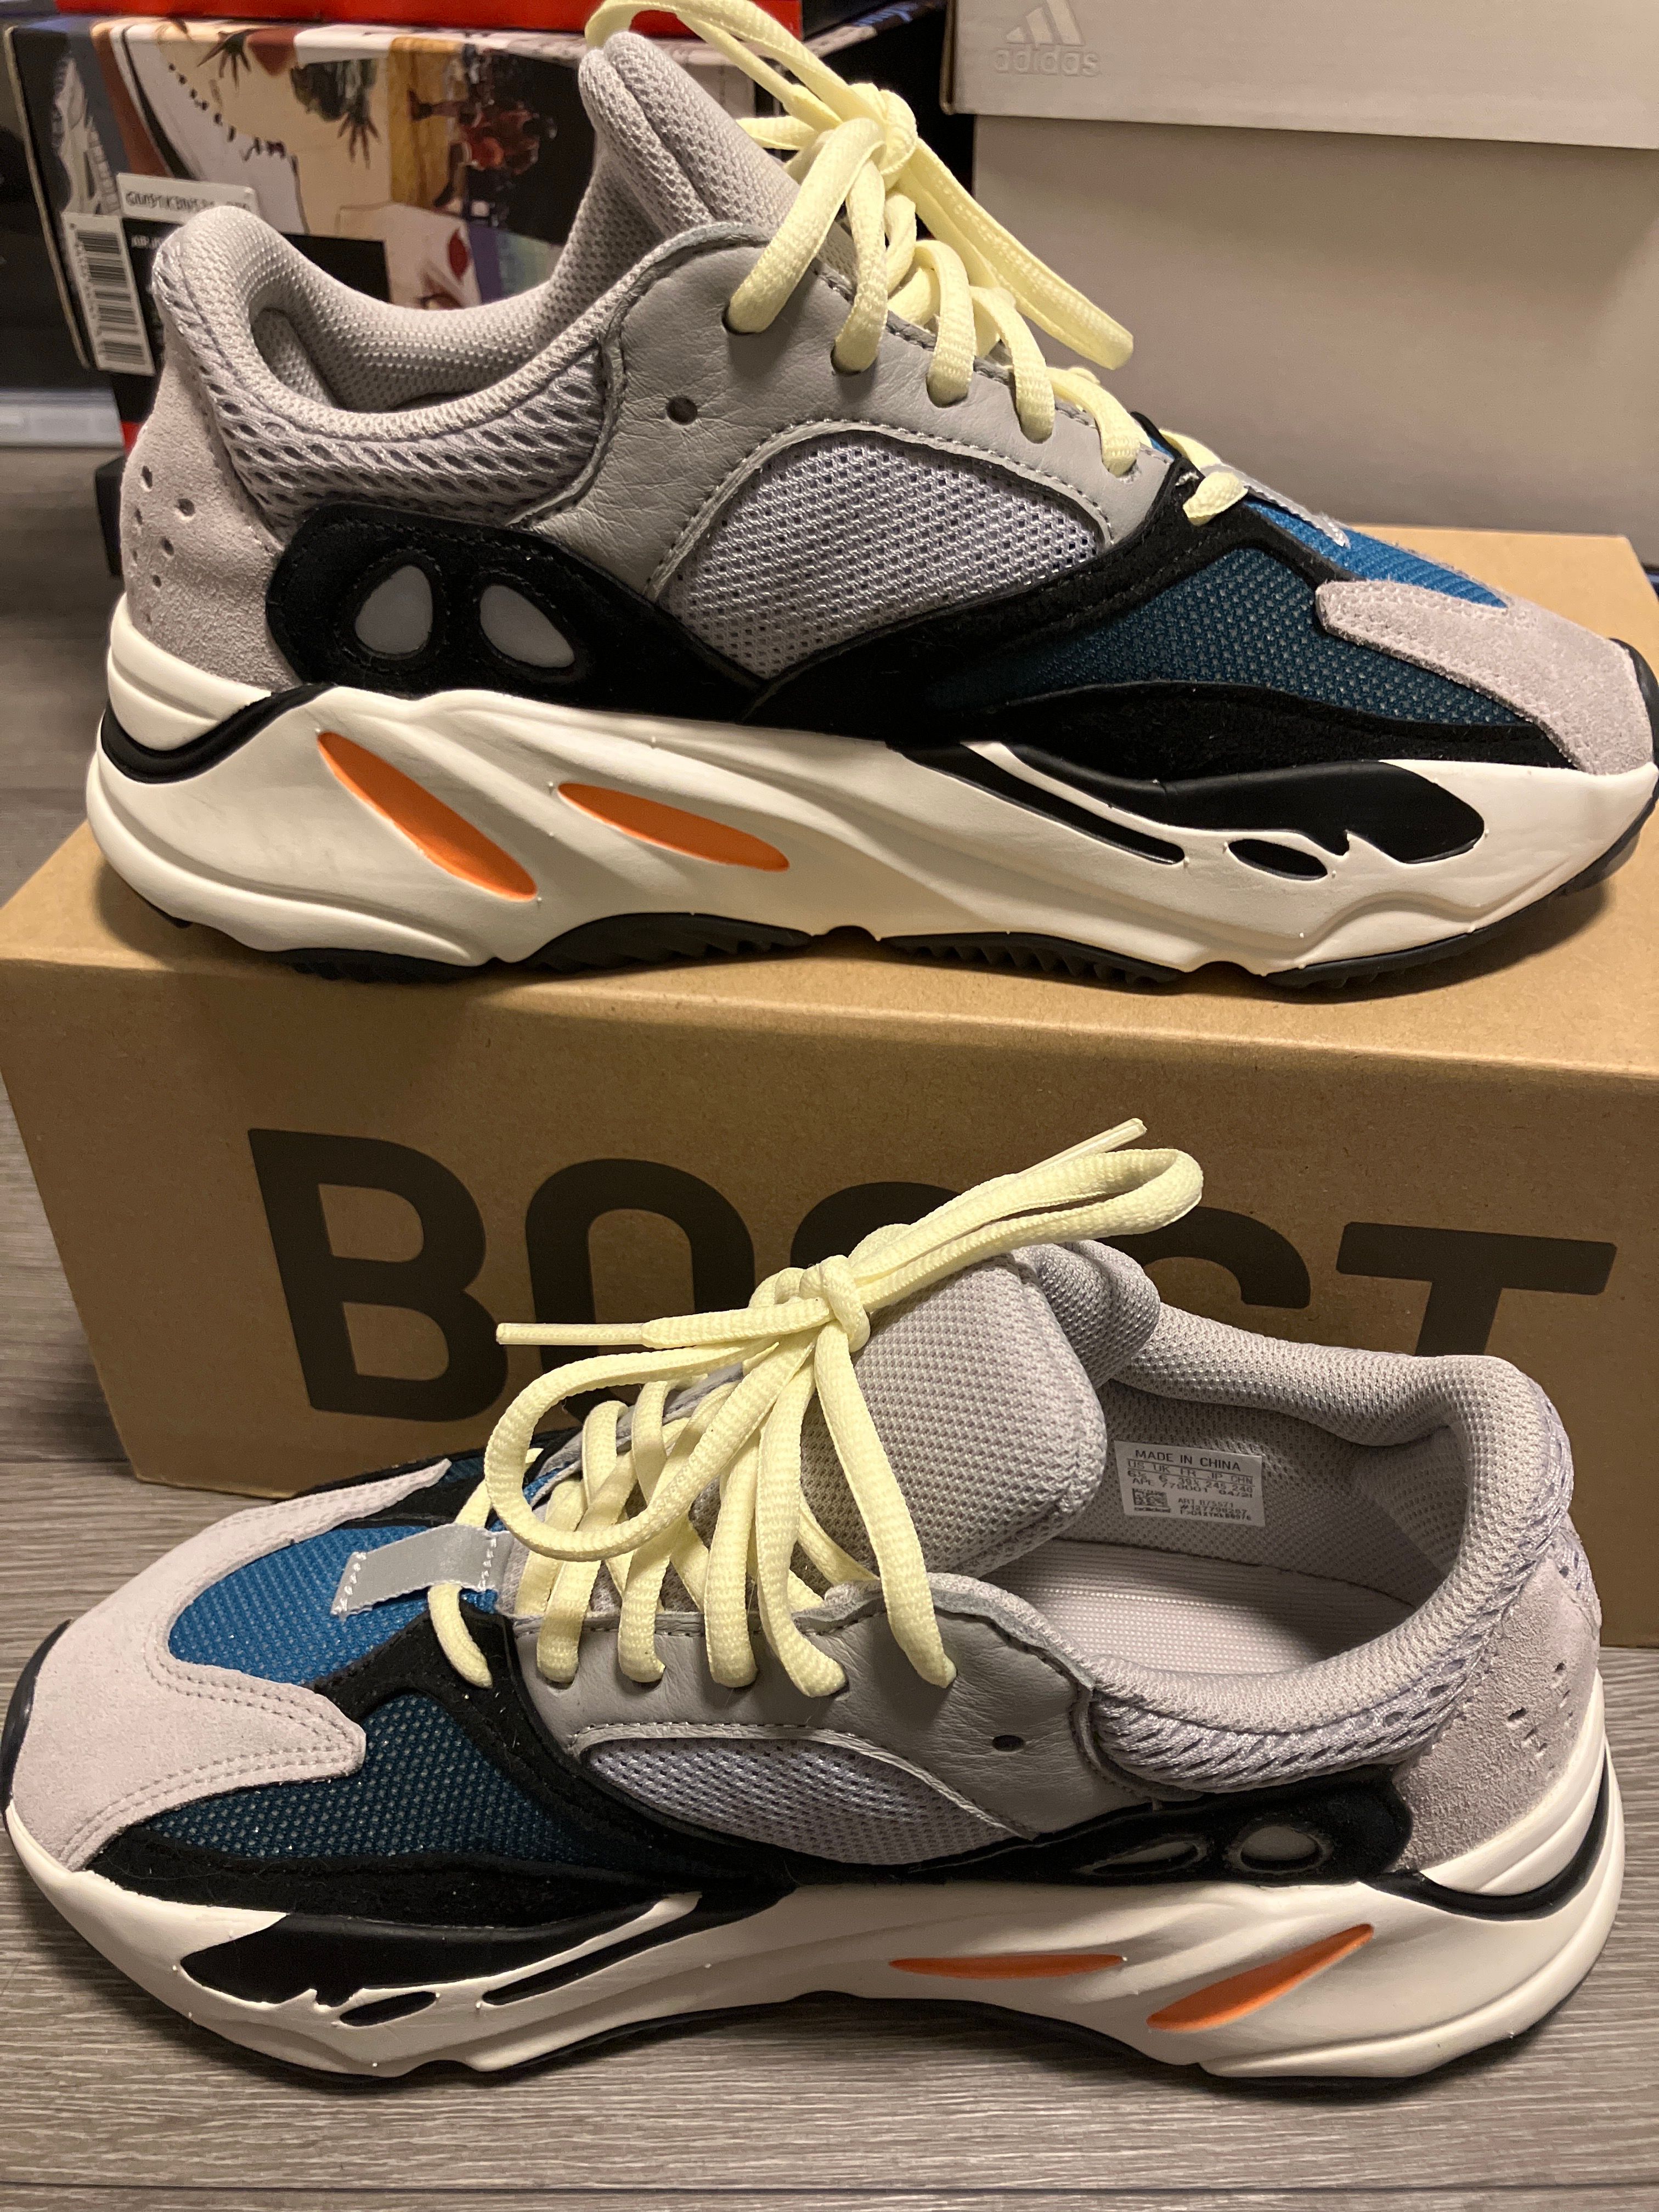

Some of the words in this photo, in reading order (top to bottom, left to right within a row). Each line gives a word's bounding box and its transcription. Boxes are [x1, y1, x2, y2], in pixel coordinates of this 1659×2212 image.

[994, 46, 1102, 77] adidas
[1128, 1460, 1145, 1469] US
[1153, 1464, 1171, 1474] UK
[1180, 1468, 1197, 1477] FR
[1207, 1472, 1223, 1480] JP
[1231, 1475, 1252, 1484] CHN
[1135, 1449, 1174, 1463] MADE
[1180, 1455, 1192, 1465] IN
[1200, 1457, 1240, 1471] CHINA
